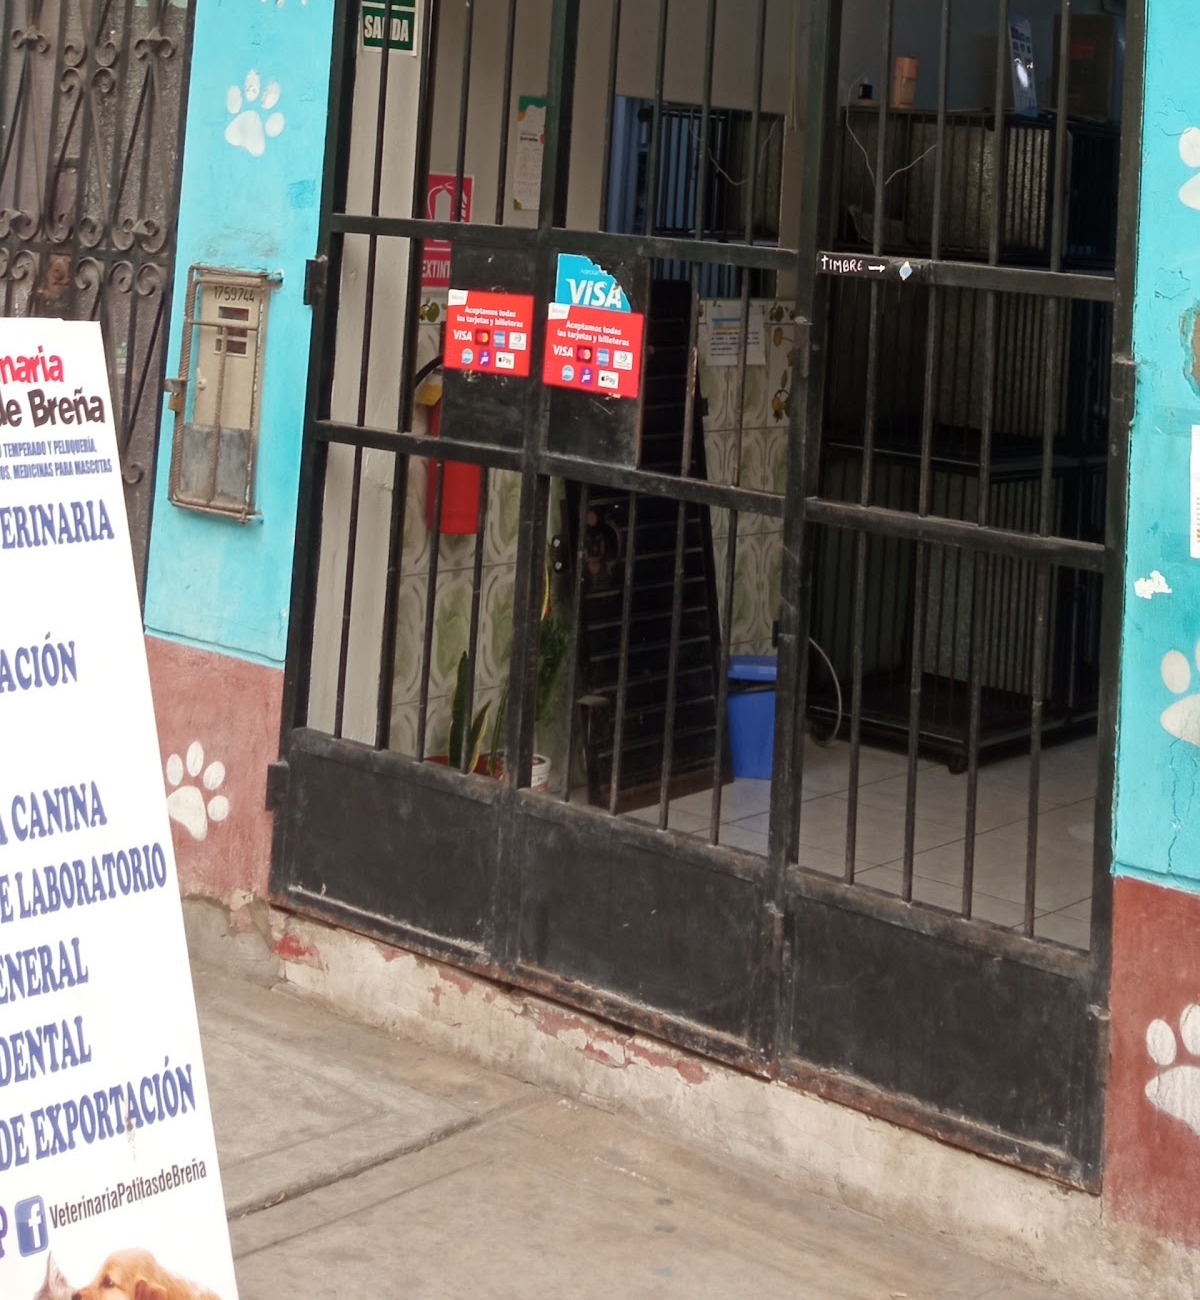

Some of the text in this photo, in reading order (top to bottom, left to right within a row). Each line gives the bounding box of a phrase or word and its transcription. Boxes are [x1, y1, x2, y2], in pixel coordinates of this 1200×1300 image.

[364, 14, 409, 42] SADA
[565, 278, 622, 308] VISA
[456, 314, 466, 322] las
[466, 316, 489, 325] tarjetas
[495, 318, 523, 328] billeteras
[464, 306, 516, 318] Aceptamos todas
[453, 329, 473, 341] VISA
[557, 329, 567, 337] las
[567, 330, 592, 341] tarjetas
[598, 334, 630, 346] billeteras
[565, 320, 622, 336] Aceptamos todas
[552, 344, 574, 357] VISA
[27, 386, 105, 428] Breña
[3, 440, 47, 458] TEMPERADO
[47, 440, 52, 455] Y
[13, 462, 54, 479] MEDICINAS
[55, 460, 74, 477] PARA
[74, 458, 113, 475] MASCOTAS
[0, 498, 115, 549] ERINARIA
[11, 780, 108, 842] CANINA
[15, 842, 167, 920] LABORATORIO
[30, 1055, 196, 1160] EXPORTACIÓN
[48, 1156, 207, 1229] VeterinariaPatitasdeBreña
